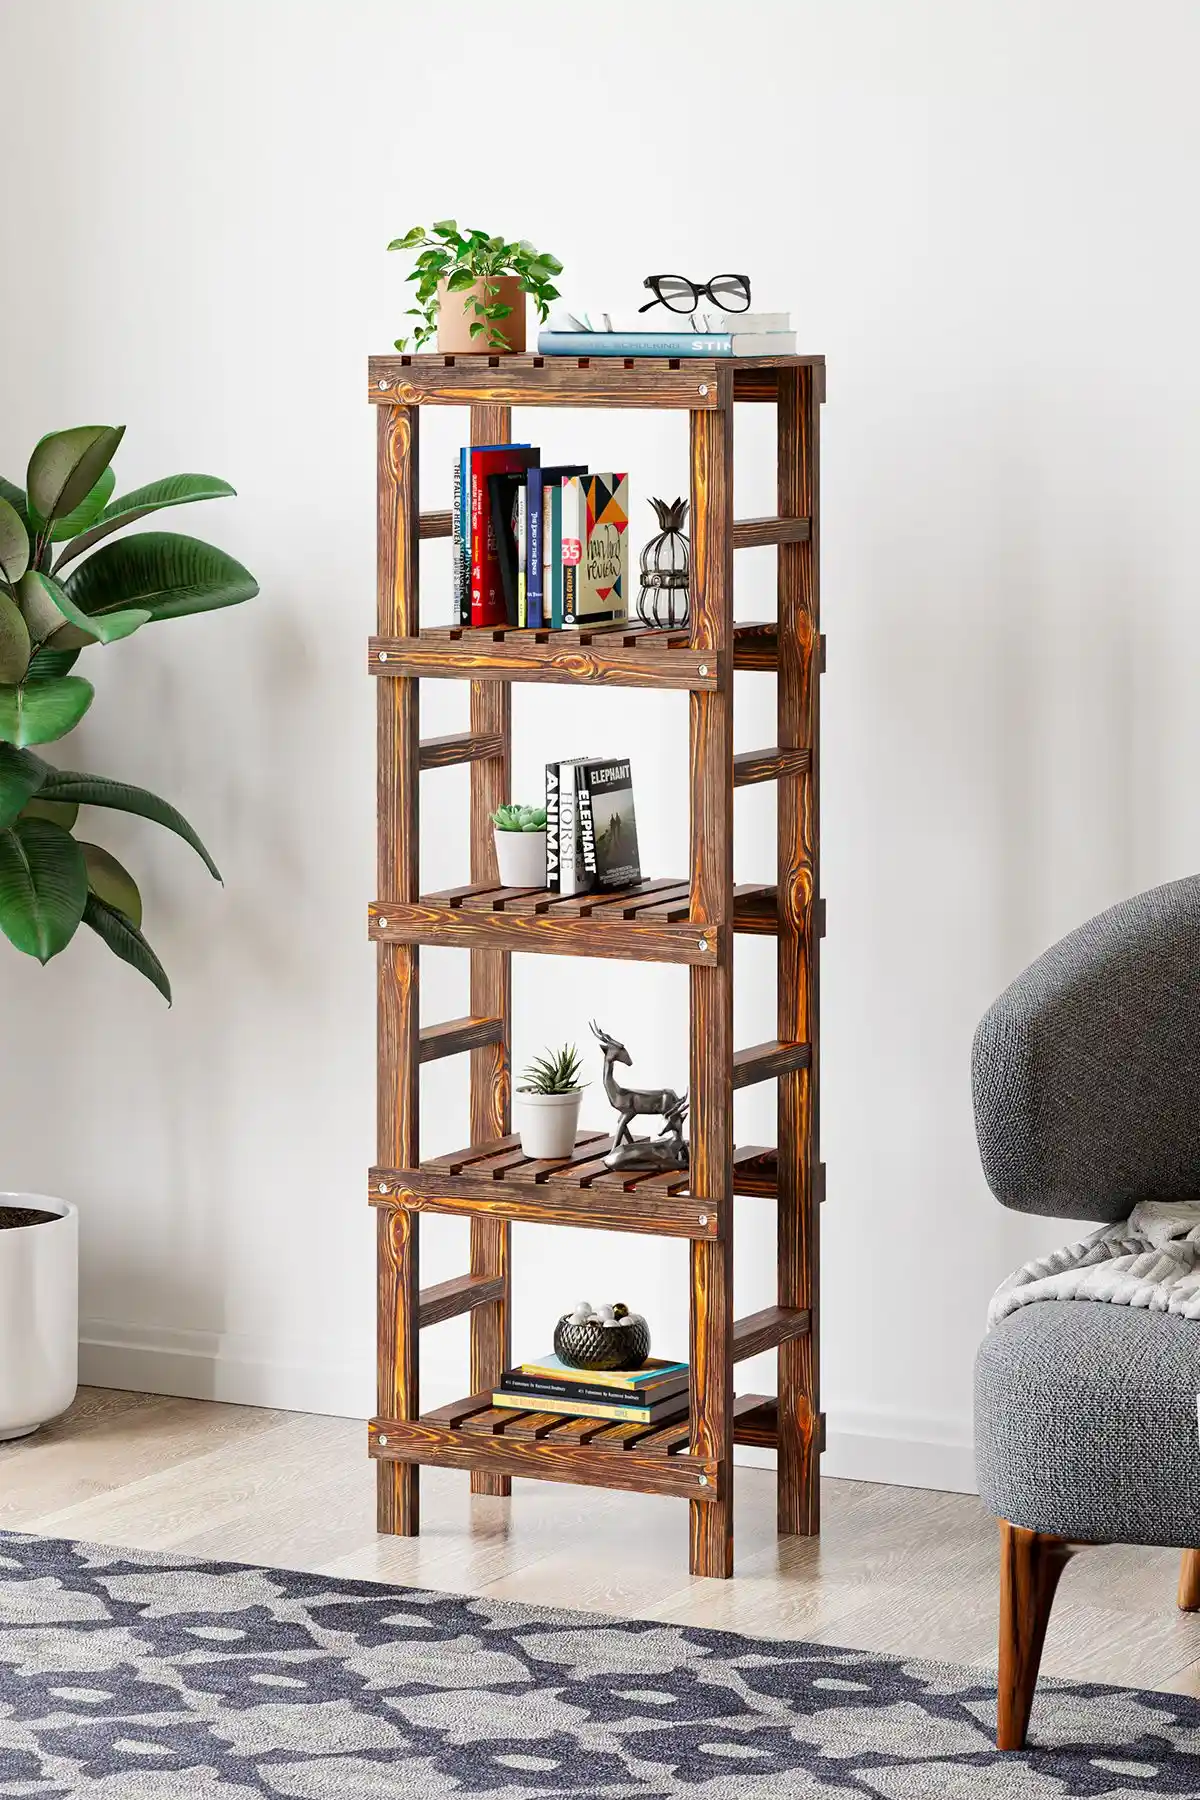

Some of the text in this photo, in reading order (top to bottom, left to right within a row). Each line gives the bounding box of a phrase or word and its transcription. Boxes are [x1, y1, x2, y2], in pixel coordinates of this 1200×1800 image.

[454, 501, 461, 511] OF
[463, 548, 472, 585] Physics
[562, 543, 580, 560] 35
[591, 764, 630, 785] ELEPHANT
[546, 771, 558, 888] ANIMAL
[560, 792, 573, 869] HORSE
[579, 790, 596, 873] ELEPHANT
